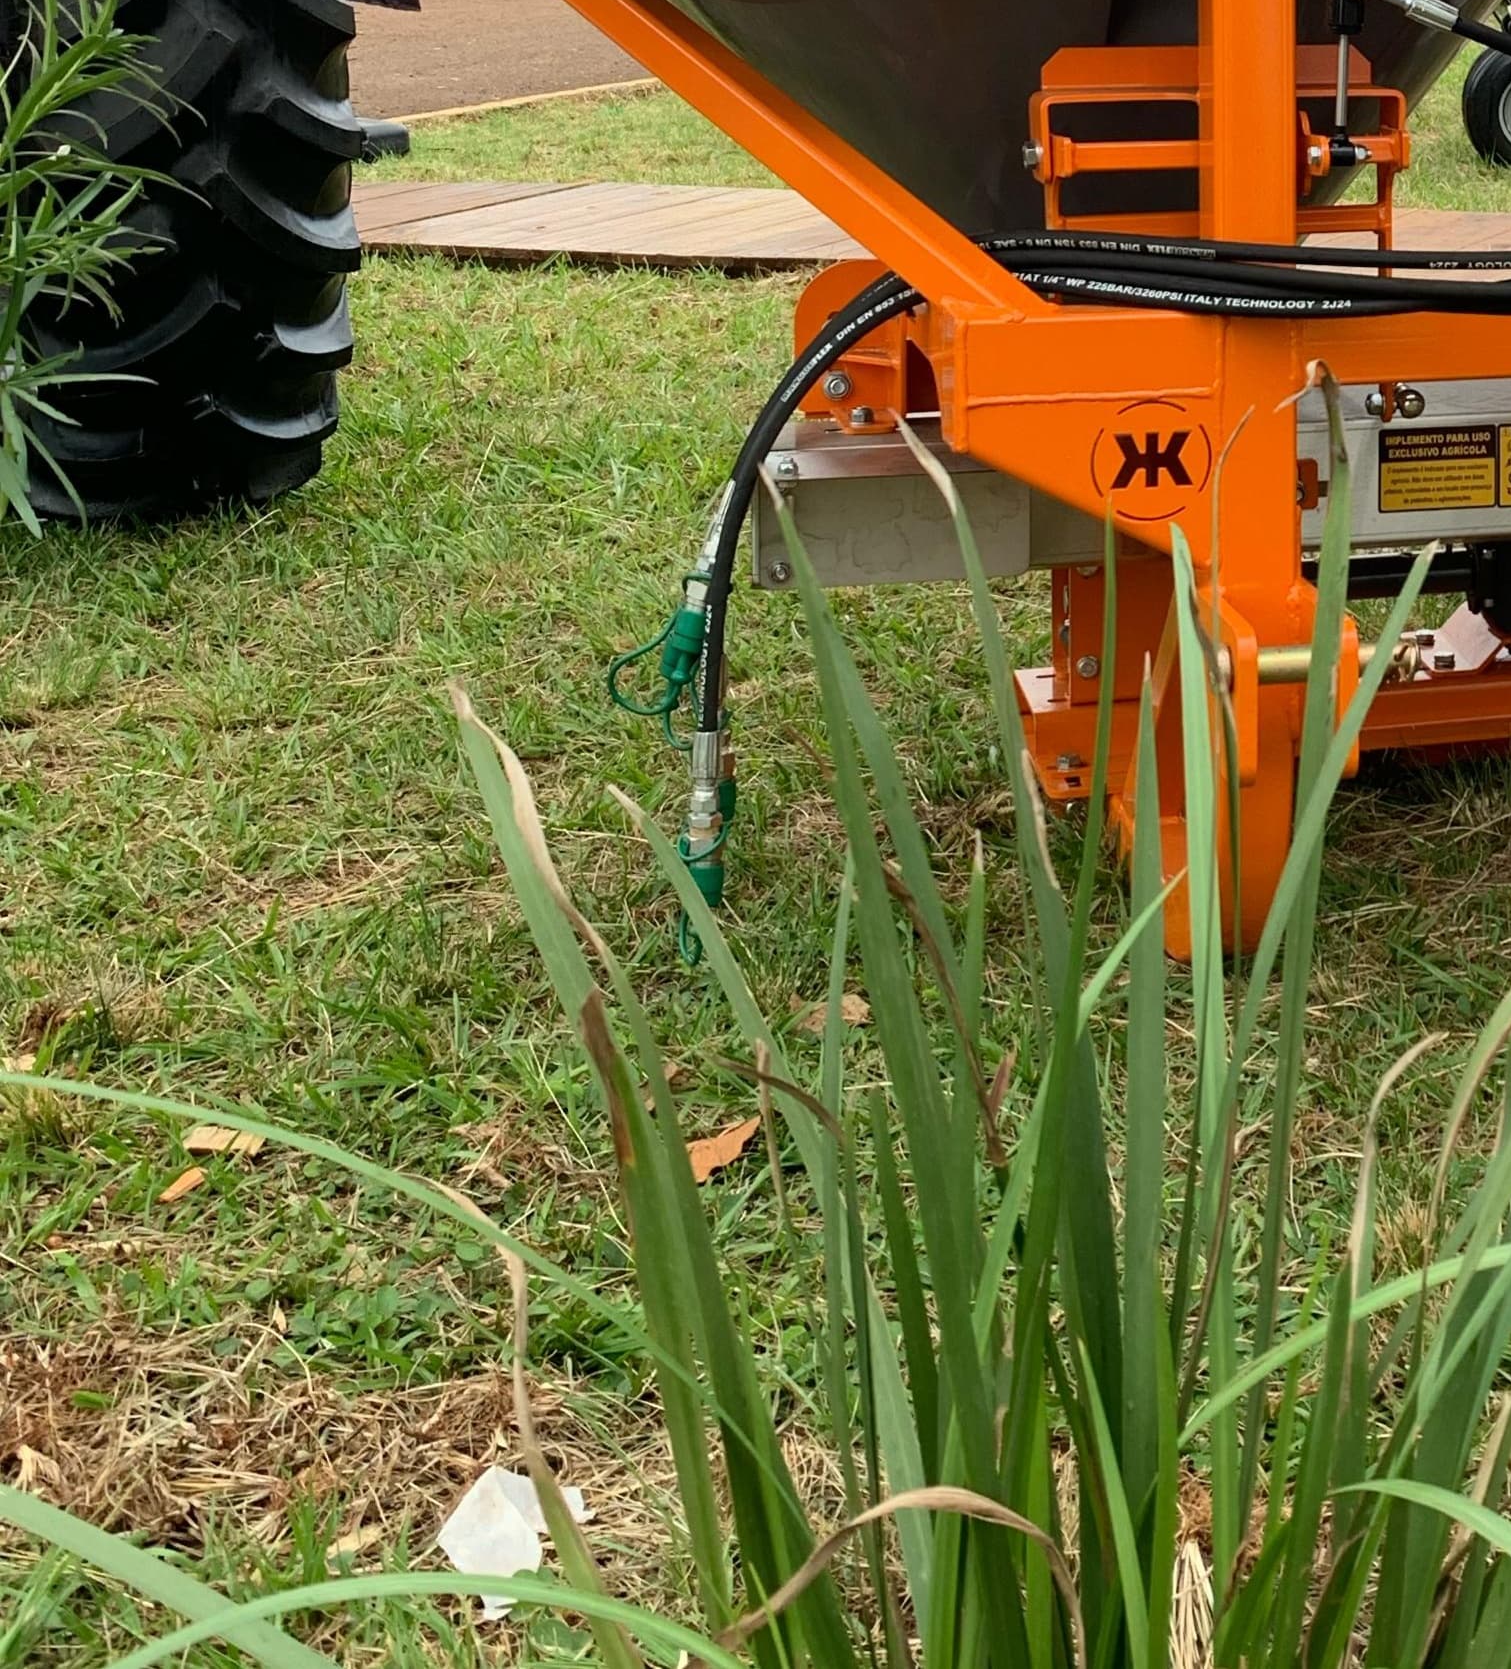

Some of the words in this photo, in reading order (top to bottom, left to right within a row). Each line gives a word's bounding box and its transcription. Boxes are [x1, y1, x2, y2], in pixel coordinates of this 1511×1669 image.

[1066, 277, 1086, 288] WP
[1086, 279, 1184, 301] 225BAR/3260PSI
[1184, 293, 1222, 305] ITALY
[1225, 297, 1316, 309] TECHNOLOGY
[1321, 299, 1352, 309] 2J24
[836, 322, 856, 341] DIN
[856, 310, 874, 324] EN
[1385, 435, 1444, 446] IMPLEMENTO
[1446, 433, 1469, 443] PARA
[1472, 432, 1491, 441] USO
[1388, 448, 1440, 458] EXCLUSIVO
[1441, 445, 1487, 456] AGRÍCOLA
